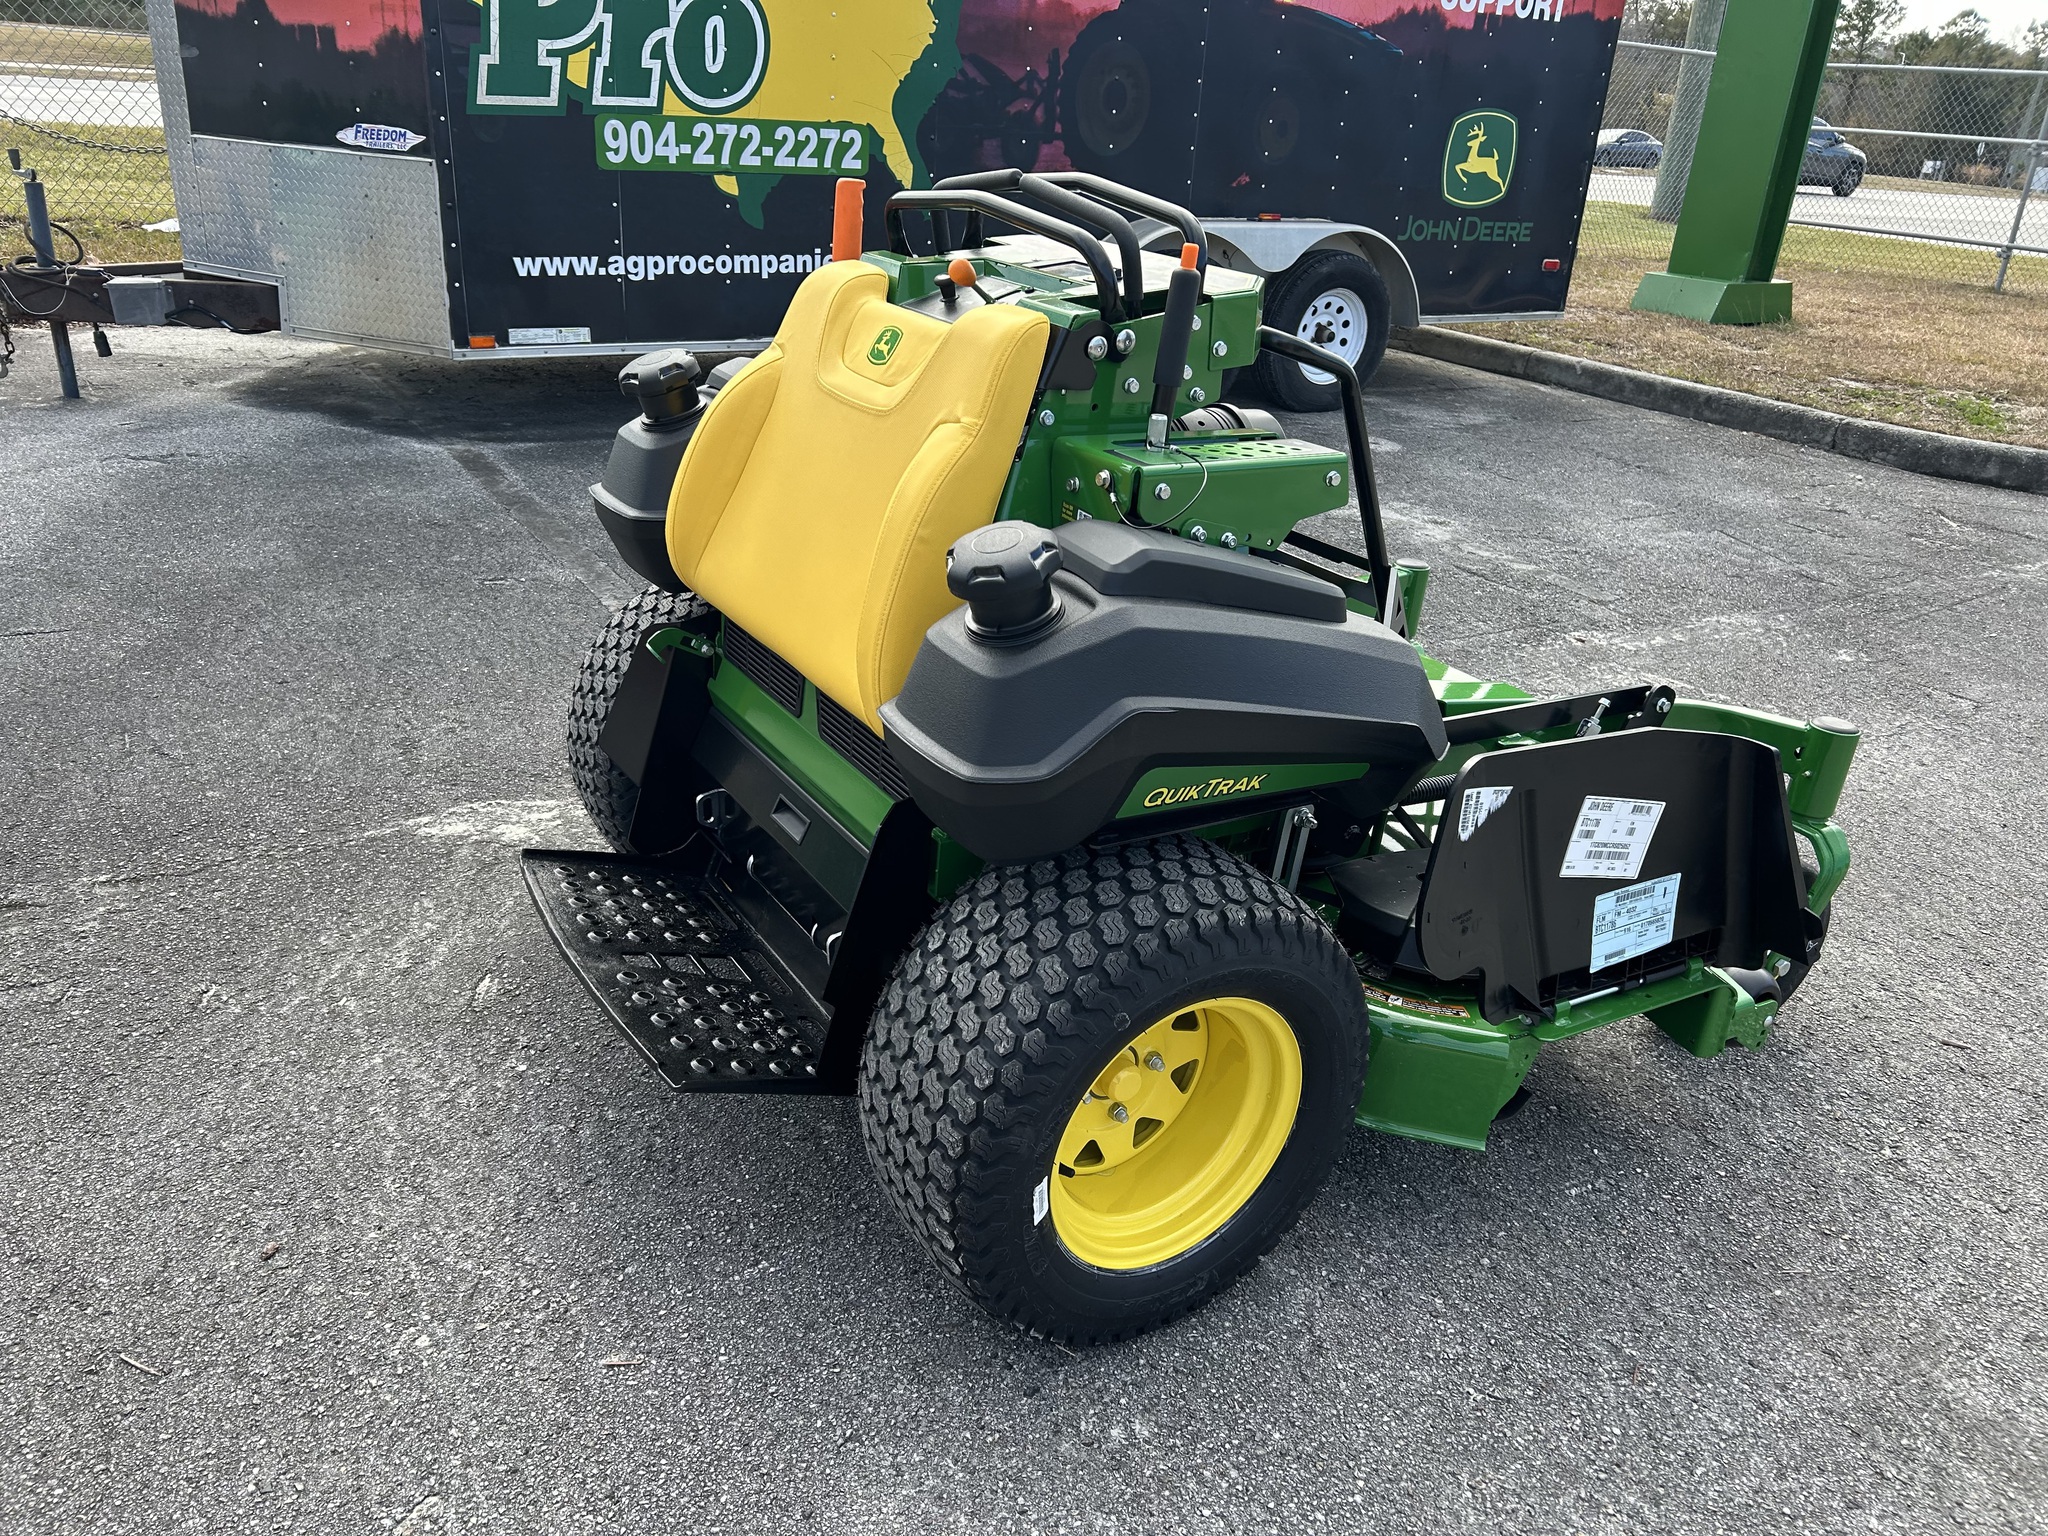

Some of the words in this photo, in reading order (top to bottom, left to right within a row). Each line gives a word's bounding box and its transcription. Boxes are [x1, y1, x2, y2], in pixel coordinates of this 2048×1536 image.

[354, 124, 407, 143] FREEDOM
[603, 118, 863, 169] 904-272-2272
[1397, 215, 1460, 242] JOHN
[1462, 216, 1534, 242] DEERE
[1588, 801, 1601, 811] JOHN
[1600, 802, 1615, 812] DEERE
